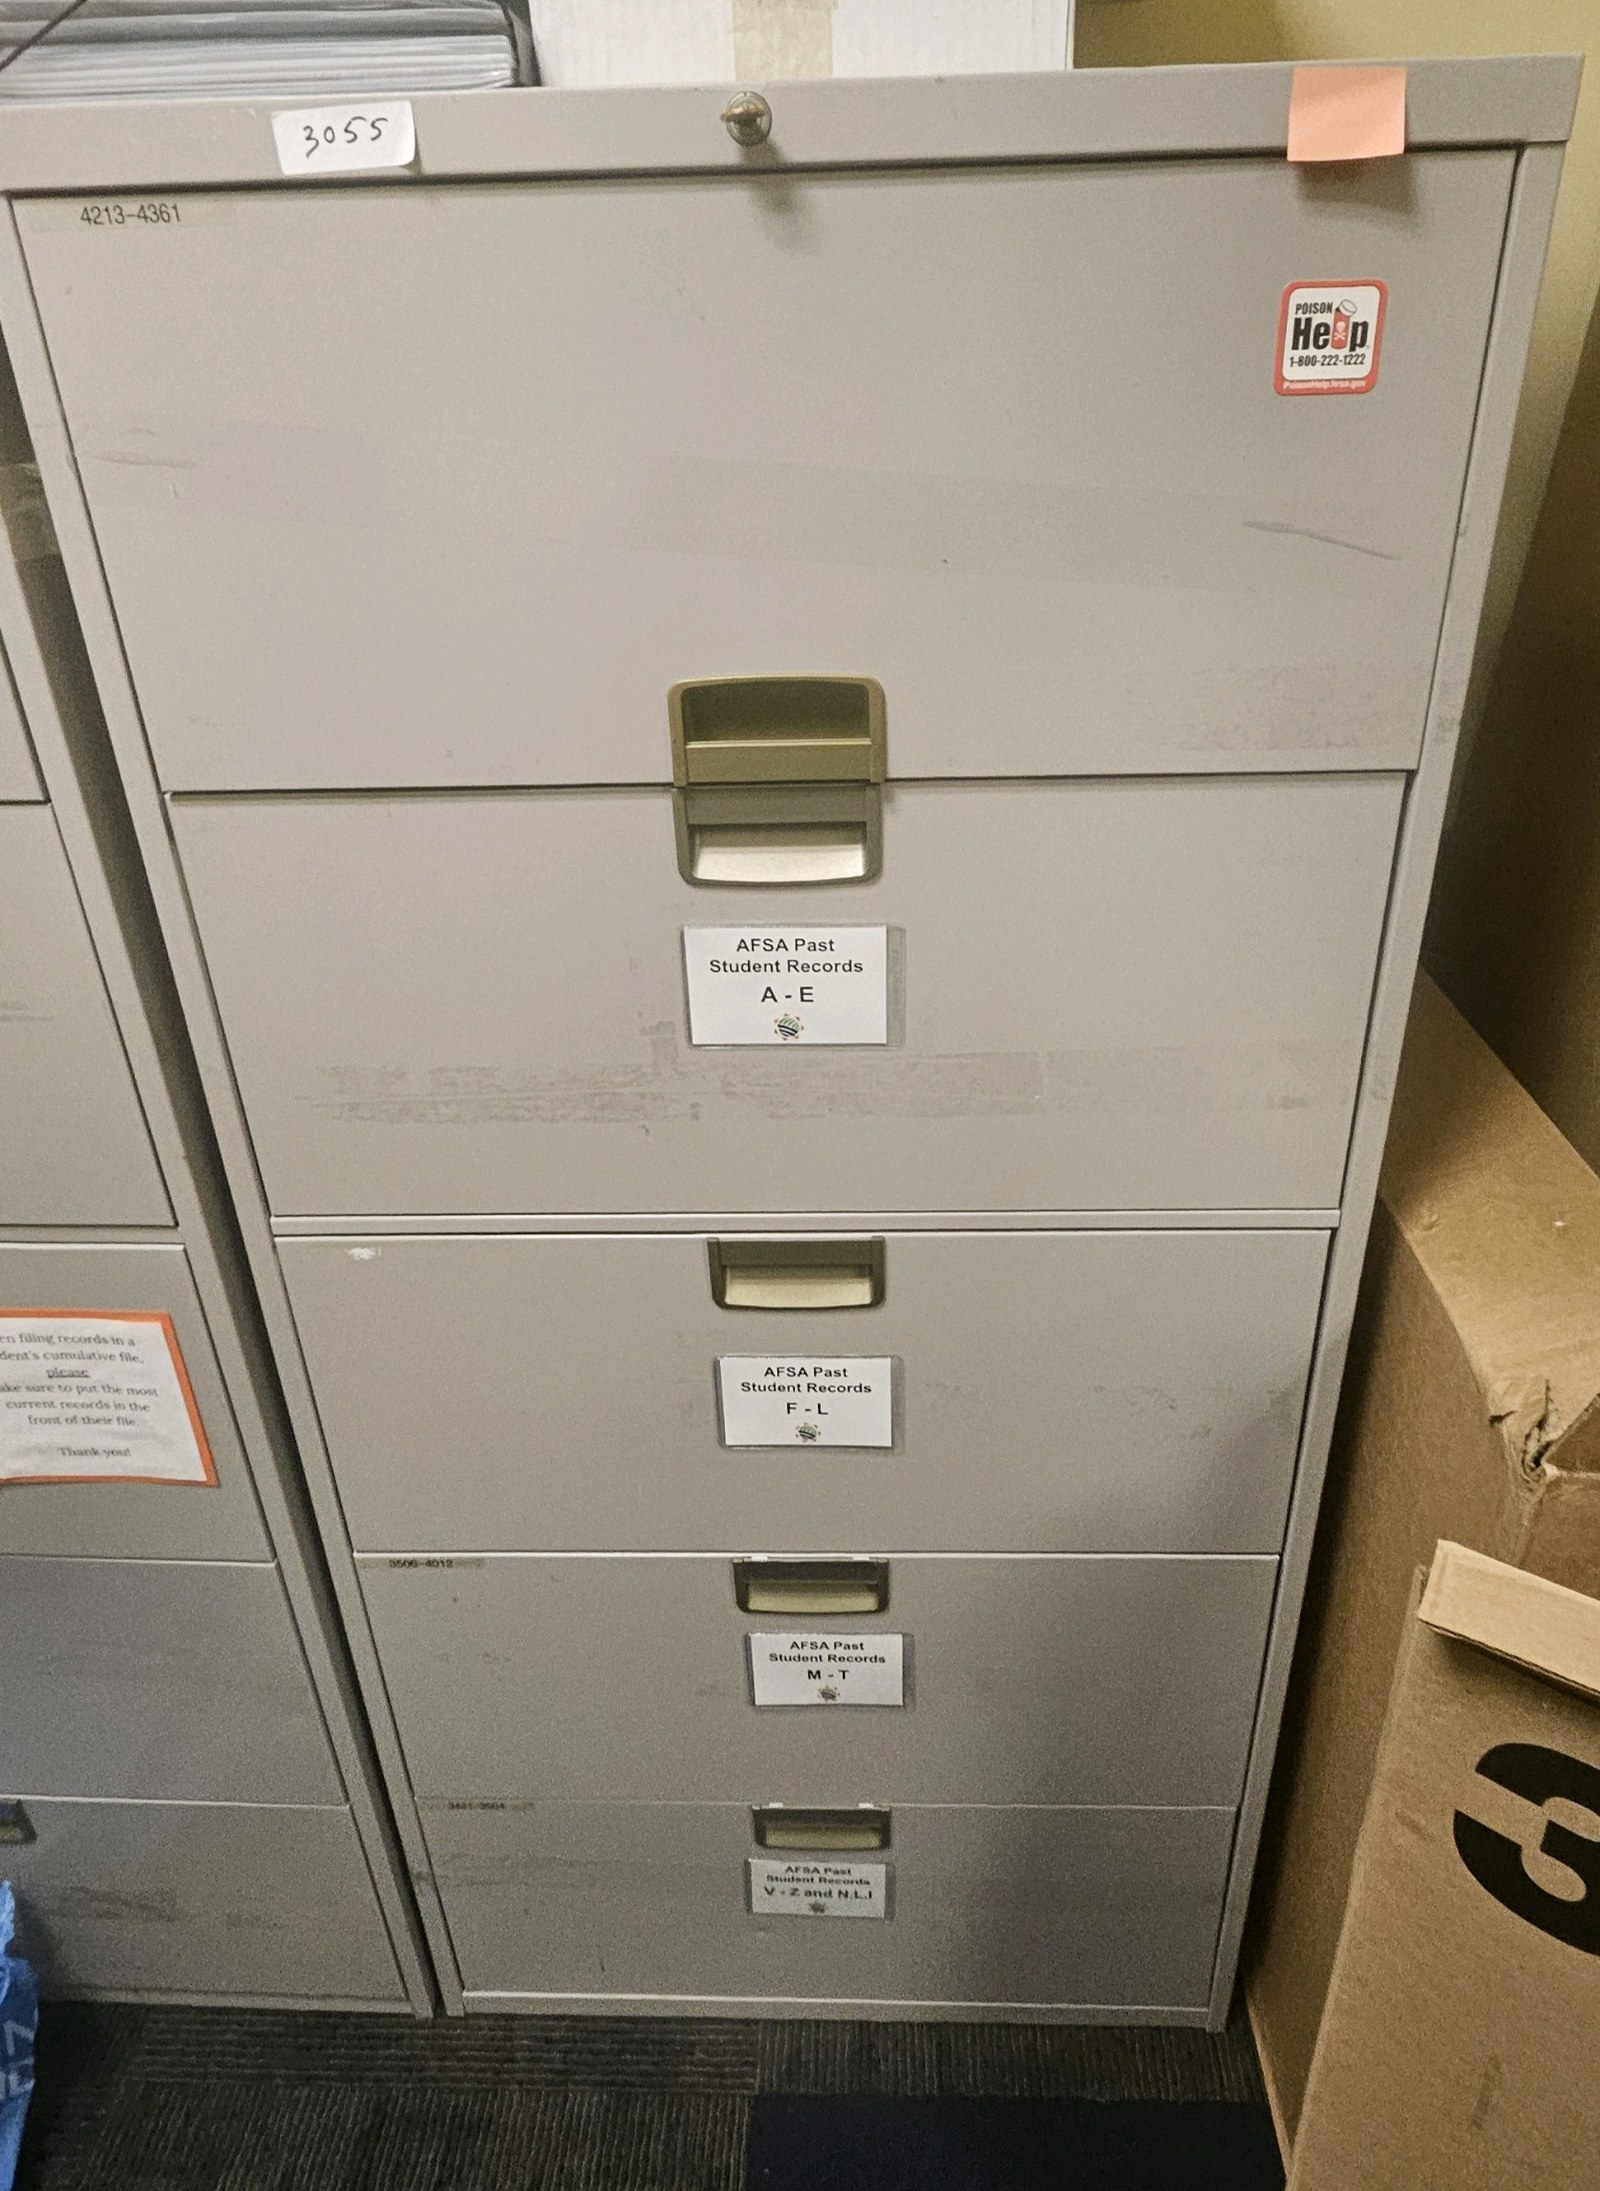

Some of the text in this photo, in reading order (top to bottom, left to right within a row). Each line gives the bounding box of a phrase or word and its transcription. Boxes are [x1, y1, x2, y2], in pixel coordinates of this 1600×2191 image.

[303, 116, 389, 159] 3055
[80, 203, 181, 225] 4213-4361
[1295, 302, 1333, 315] POISON
[1289, 353, 1366, 367] 1-800-222-1222
[736, 938, 835, 952] AFSA Past
[709, 959, 863, 973] Student Records
[761, 986, 778, 1003] A
[800, 986, 814, 1003] E
[19, 1333, 55, 1346] filing
[57, 1334, 109, 1344] records
[111, 1335, 125, 1346] in
[128, 1337, 136, 1347] a
[43, 1350, 116, 1362] cumulative
[119, 1351, 144, 1364] file,
[46, 1367, 90, 1378] please
[764, 1366, 848, 1378] AFSA Past
[25, 1384, 54, 1393] sure
[57, 1384, 72, 1393] to
[76, 1384, 98, 1395] put
[101, 1383, 122, 1394] the
[126, 1385, 159, 1397] most
[741, 1382, 872, 1393] Student Records
[6, 1399, 151, 1412] current records in the
[786, 1402, 797, 1415] F
[817, 1403, 829, 1415] L
[28, 1414, 62, 1425] front
[65, 1414, 78, 1425] of
[82, 1414, 113, 1425] their
[58, 1447, 99, 1457] Thank
[790, 1641, 865, 1650] AFSA Past
[769, 1653, 886, 1663] Student Records
[807, 1670, 821, 1680] M
[838, 1670, 850, 1680] T
[785, 1866, 852, 1875] AFSA Past
[766, 1875, 871, 1885] Student Records
[764, 1886, 775, 1895] V
[804, 1889, 833, 1898] and
